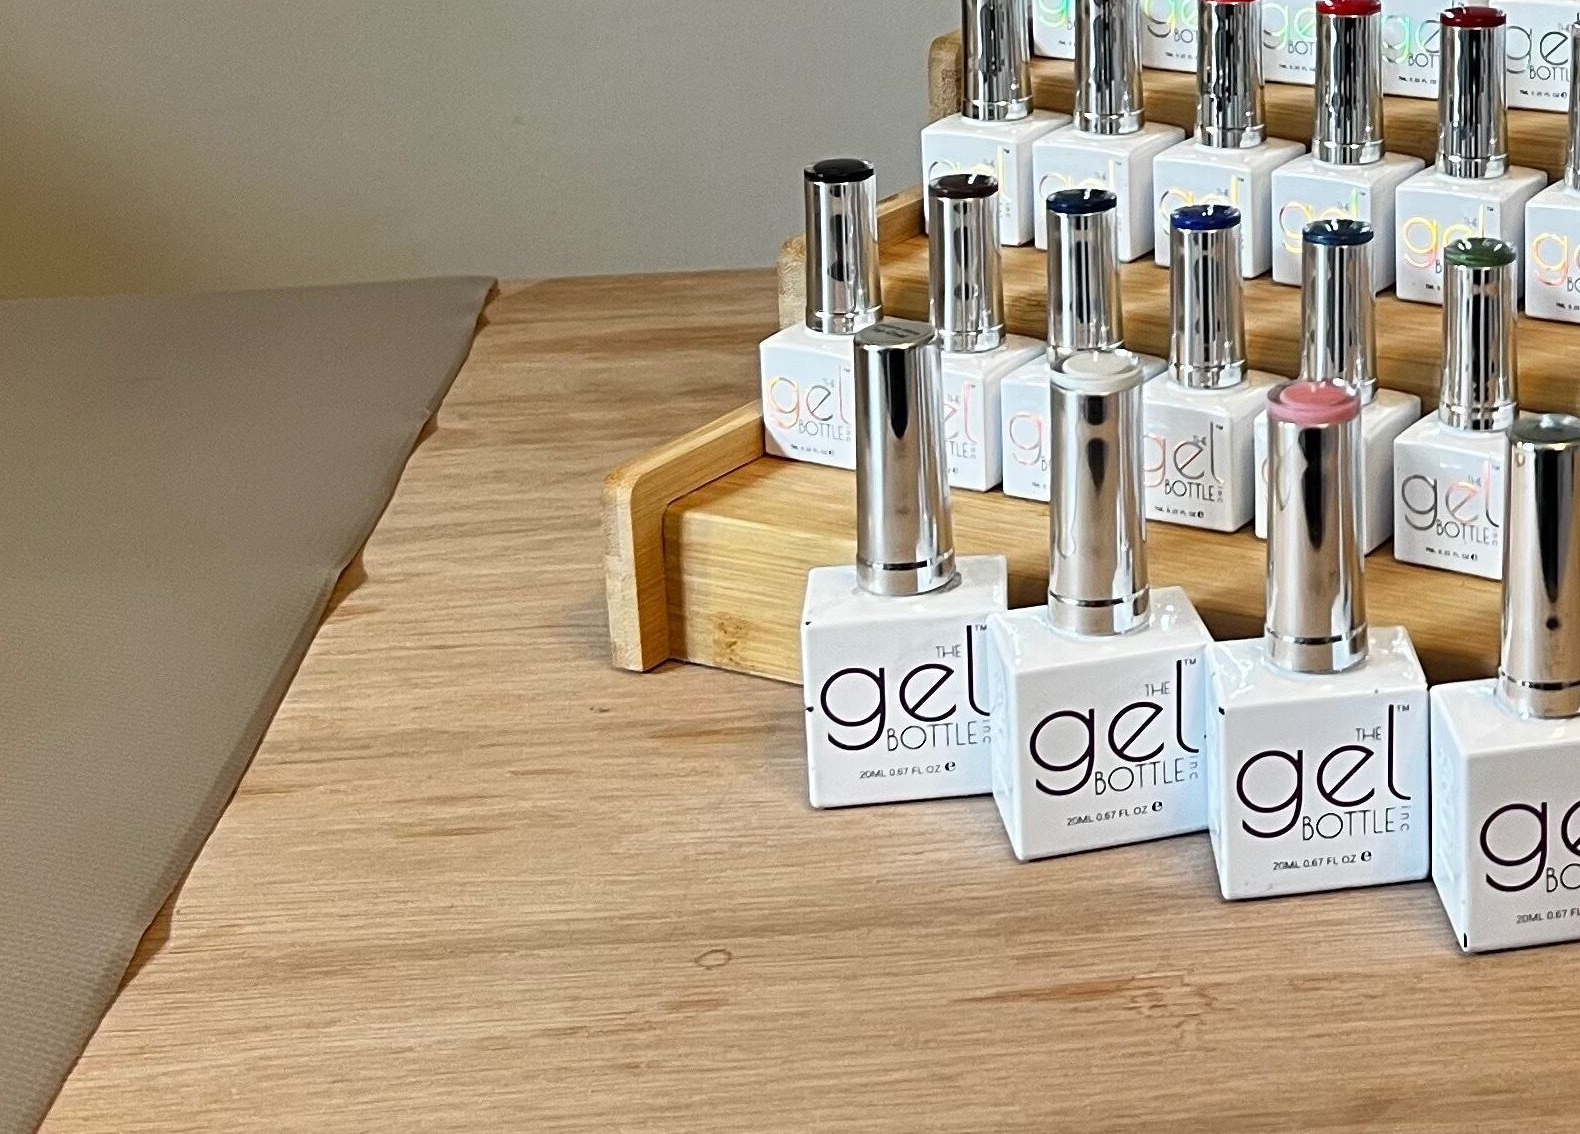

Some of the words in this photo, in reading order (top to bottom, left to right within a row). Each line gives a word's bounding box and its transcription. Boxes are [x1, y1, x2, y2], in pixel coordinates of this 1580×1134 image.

[1529, 65, 1570, 83] BOTTL
[769, 366, 851, 430] gel
[799, 418, 846, 441] BOTTLE
[1165, 478, 1215, 502] BOTTLE
[1401, 460, 1500, 532] gel
[1436, 518, 1490, 546] BOTTLE
[936, 645, 961, 658] THE
[820, 625, 990, 751] gel
[1145, 681, 1170, 697] THE
[887, 720, 978, 752] BOTTLE
[1030, 660, 1199, 795] gel
[1355, 726, 1382, 742] THE
[911, 766, 927, 775] FL
[929, 764, 941, 774] OZ
[1095, 758, 1185, 796] BOTTLE
[1236, 704, 1411, 838] gel
[1118, 808, 1131, 819] FL
[1133, 805, 1148, 816] OZ
[1302, 806, 1395, 841] BOTTLE
[1327, 856, 1339, 866] FL
[1341, 853, 1357, 864] OZ
